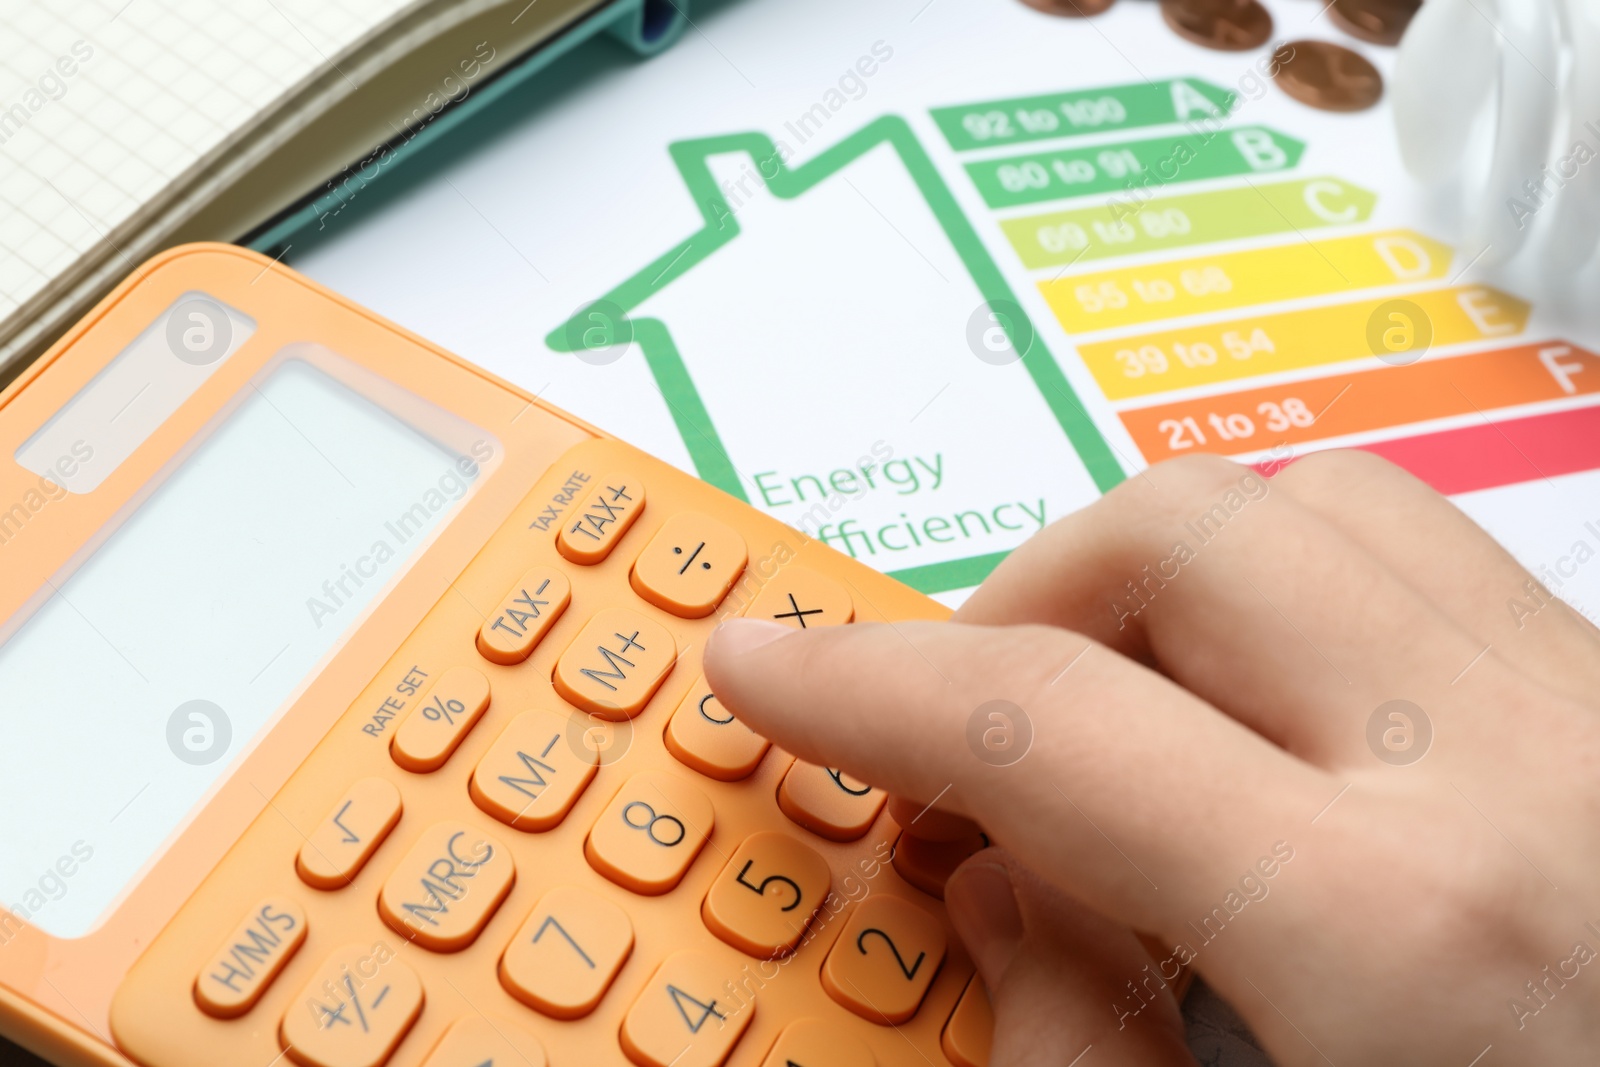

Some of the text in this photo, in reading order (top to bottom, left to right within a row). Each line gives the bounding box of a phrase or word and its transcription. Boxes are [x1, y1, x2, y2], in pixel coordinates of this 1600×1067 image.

[962, 80, 1229, 140] 92 to 100 A
[1231, 128, 1287, 172] B
[1304, 180, 1358, 223] C
[1075, 236, 1431, 313] 55 to 68 D
[1115, 290, 1517, 378] 39 to 54 E
[1159, 345, 1584, 451] 21 to 38 F
[528, 470, 591, 533] TAX RATE
[753, 453, 942, 507] Energy
[570, 485, 633, 541] TAX+
[818, 497, 1047, 559] fficiency
[491, 578, 551, 637] TAX-
[579, 630, 646, 692] M+
[361, 665, 429, 737] RATE SET
[422, 695, 466, 725] %
[498, 734, 560, 800] M-
[622, 800, 686, 847] 8
[402, 831, 494, 926] MRC
[736, 859, 802, 912] 5
[210, 904, 296, 993] H/M/S
[532, 916, 596, 970] 7
[856, 928, 926, 981] 2
[666, 983, 726, 1035] 4
